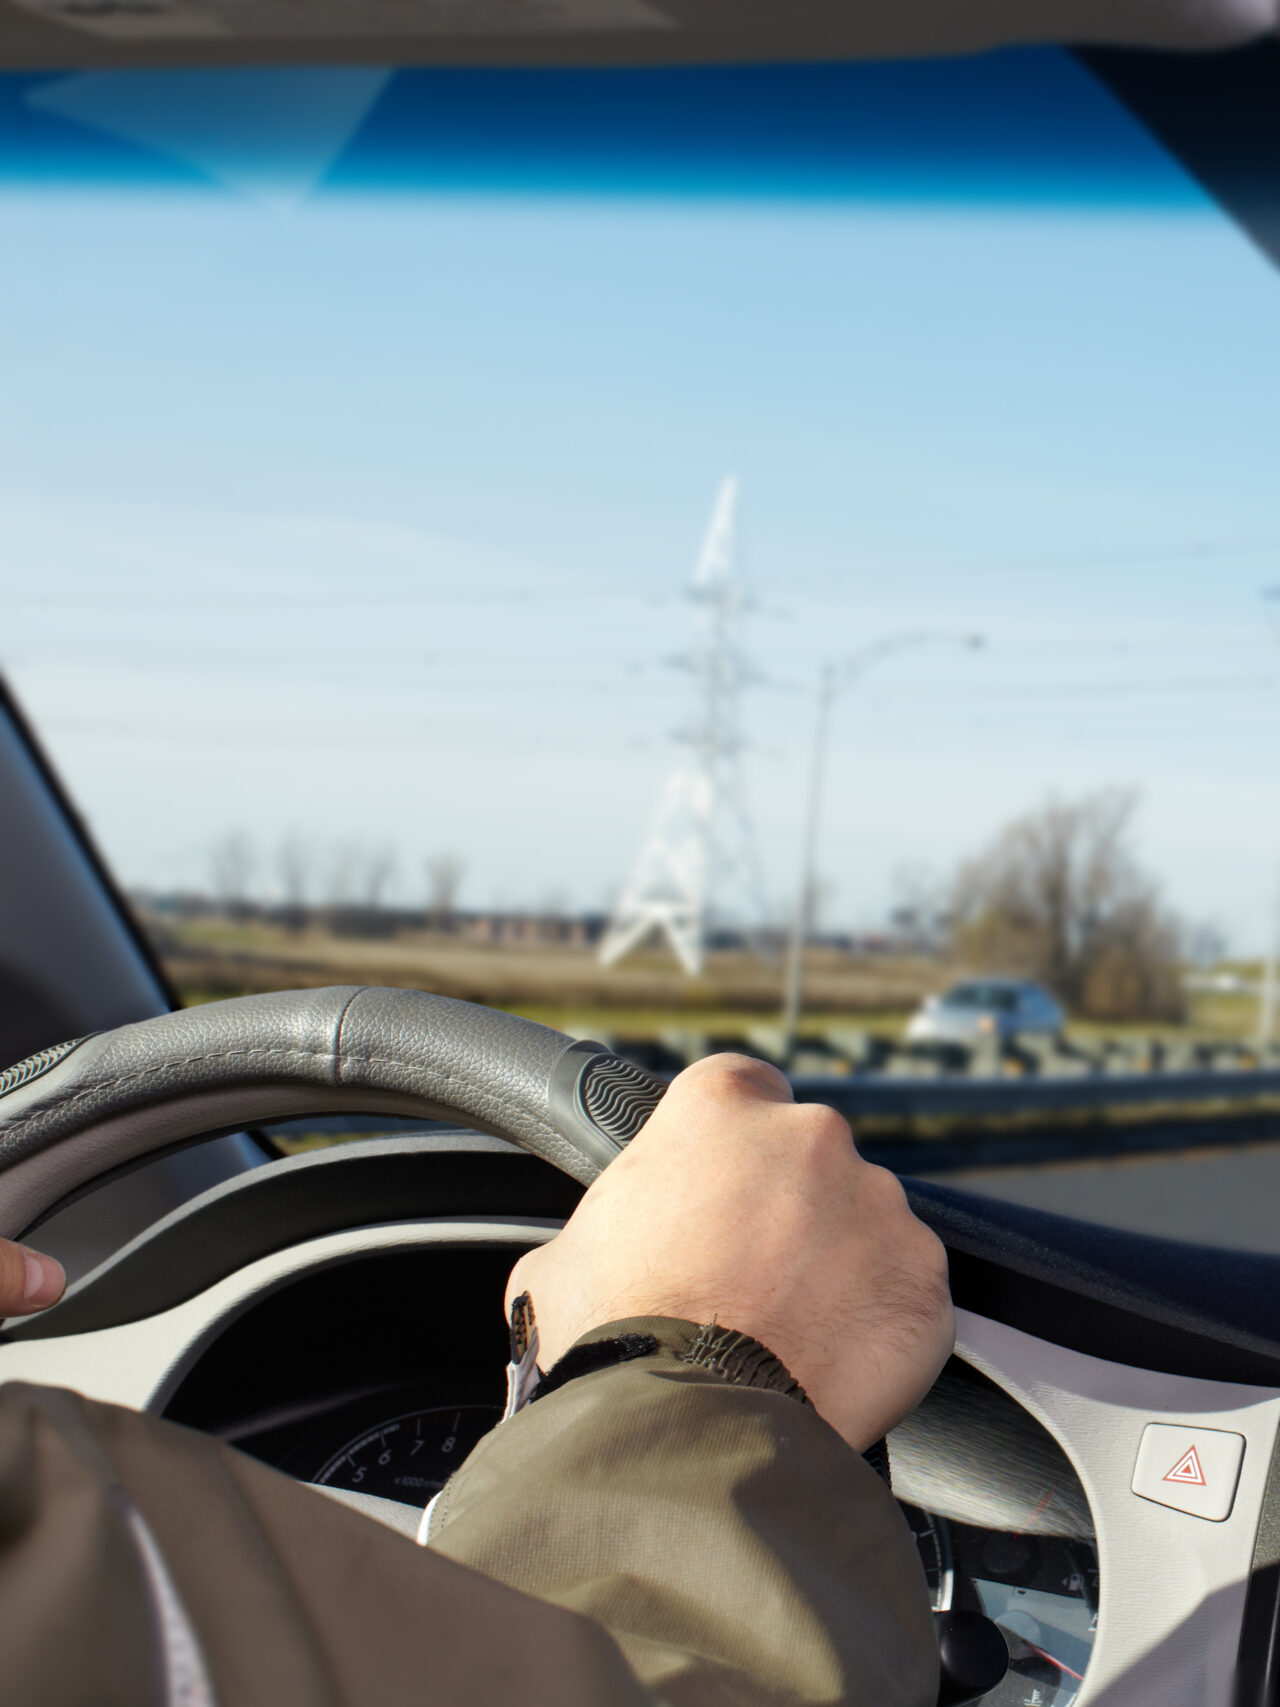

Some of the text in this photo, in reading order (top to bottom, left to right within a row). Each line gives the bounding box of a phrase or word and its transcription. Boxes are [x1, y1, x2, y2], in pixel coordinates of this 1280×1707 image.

[352, 1436, 456, 1483] 5 6 7 8
